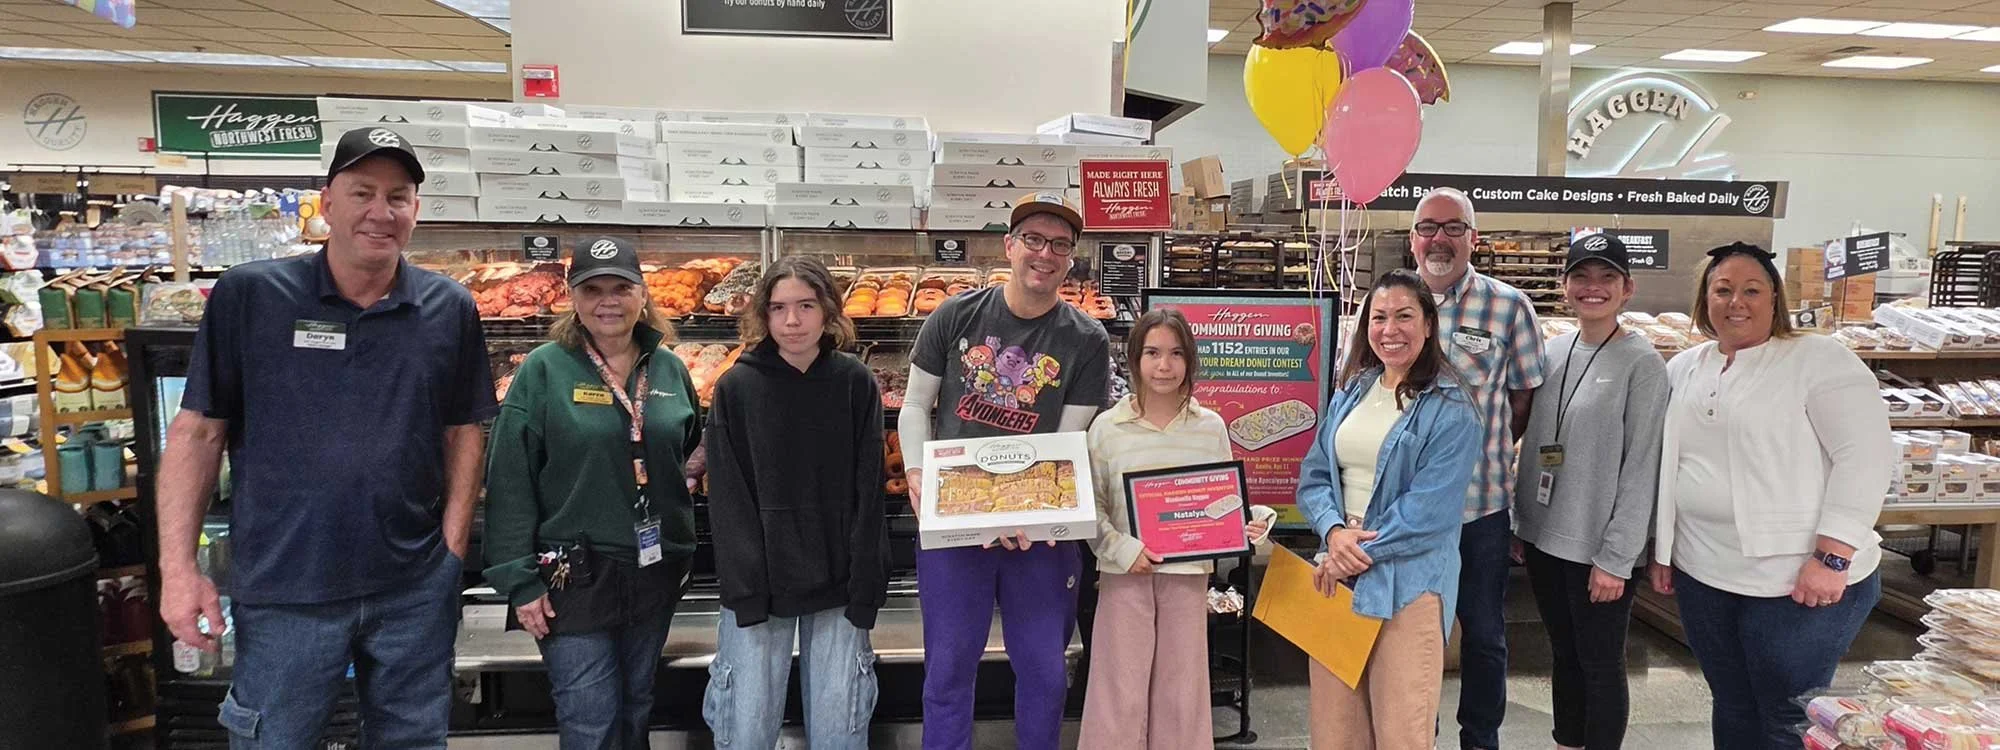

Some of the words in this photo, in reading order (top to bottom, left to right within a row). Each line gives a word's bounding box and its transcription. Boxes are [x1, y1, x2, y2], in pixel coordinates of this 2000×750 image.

[807, 0, 826, 9] daily
[187, 103, 322, 132] Haggen
[1567, 87, 1688, 159] HAGGEN
[213, 128, 276, 146] NORTHWEST
[279, 126, 314, 141] FRESH
[1087, 171, 1111, 179] MADE
[1113, 171, 1139, 179] RIGHT
[1141, 171, 1164, 179] HERE
[1093, 181, 1130, 198] ALWAYS
[1133, 181, 1160, 198] FRESH
[1472, 187, 1523, 200] Custom
[1526, 188, 1559, 200] Cake
[1563, 189, 1614, 204] Designs
[1627, 191, 1664, 203] Fresh
[1667, 192, 1705, 204] Baked
[1709, 193, 1739, 206] Daily
[1100, 202, 1153, 215] Haggen
[1208, 308, 1270, 322] Haggen
[1188, 323, 1251, 337] OMMUNITY
[1253, 324, 1292, 337] GIVING
[1211, 342, 1244, 355] 1152
[1244, 346, 1268, 355] ENTRIES
[1269, 347, 1276, 355] IN
[1277, 347, 1289, 355] OUR
[1199, 357, 1218, 367] YOUR
[1220, 358, 1245, 368] DREAM
[1246, 358, 1271, 368] DONUT
[1272, 359, 1303, 368] CONTEST
[1193, 382, 1267, 397] Congratulations
[955, 391, 1041, 434] AVONGERS
[980, 453, 1032, 464] DONUTS
[1174, 476, 1209, 486] COMMUNITY
[1209, 474, 1230, 482] GIVING
[1174, 509, 1206, 519] Natalya
